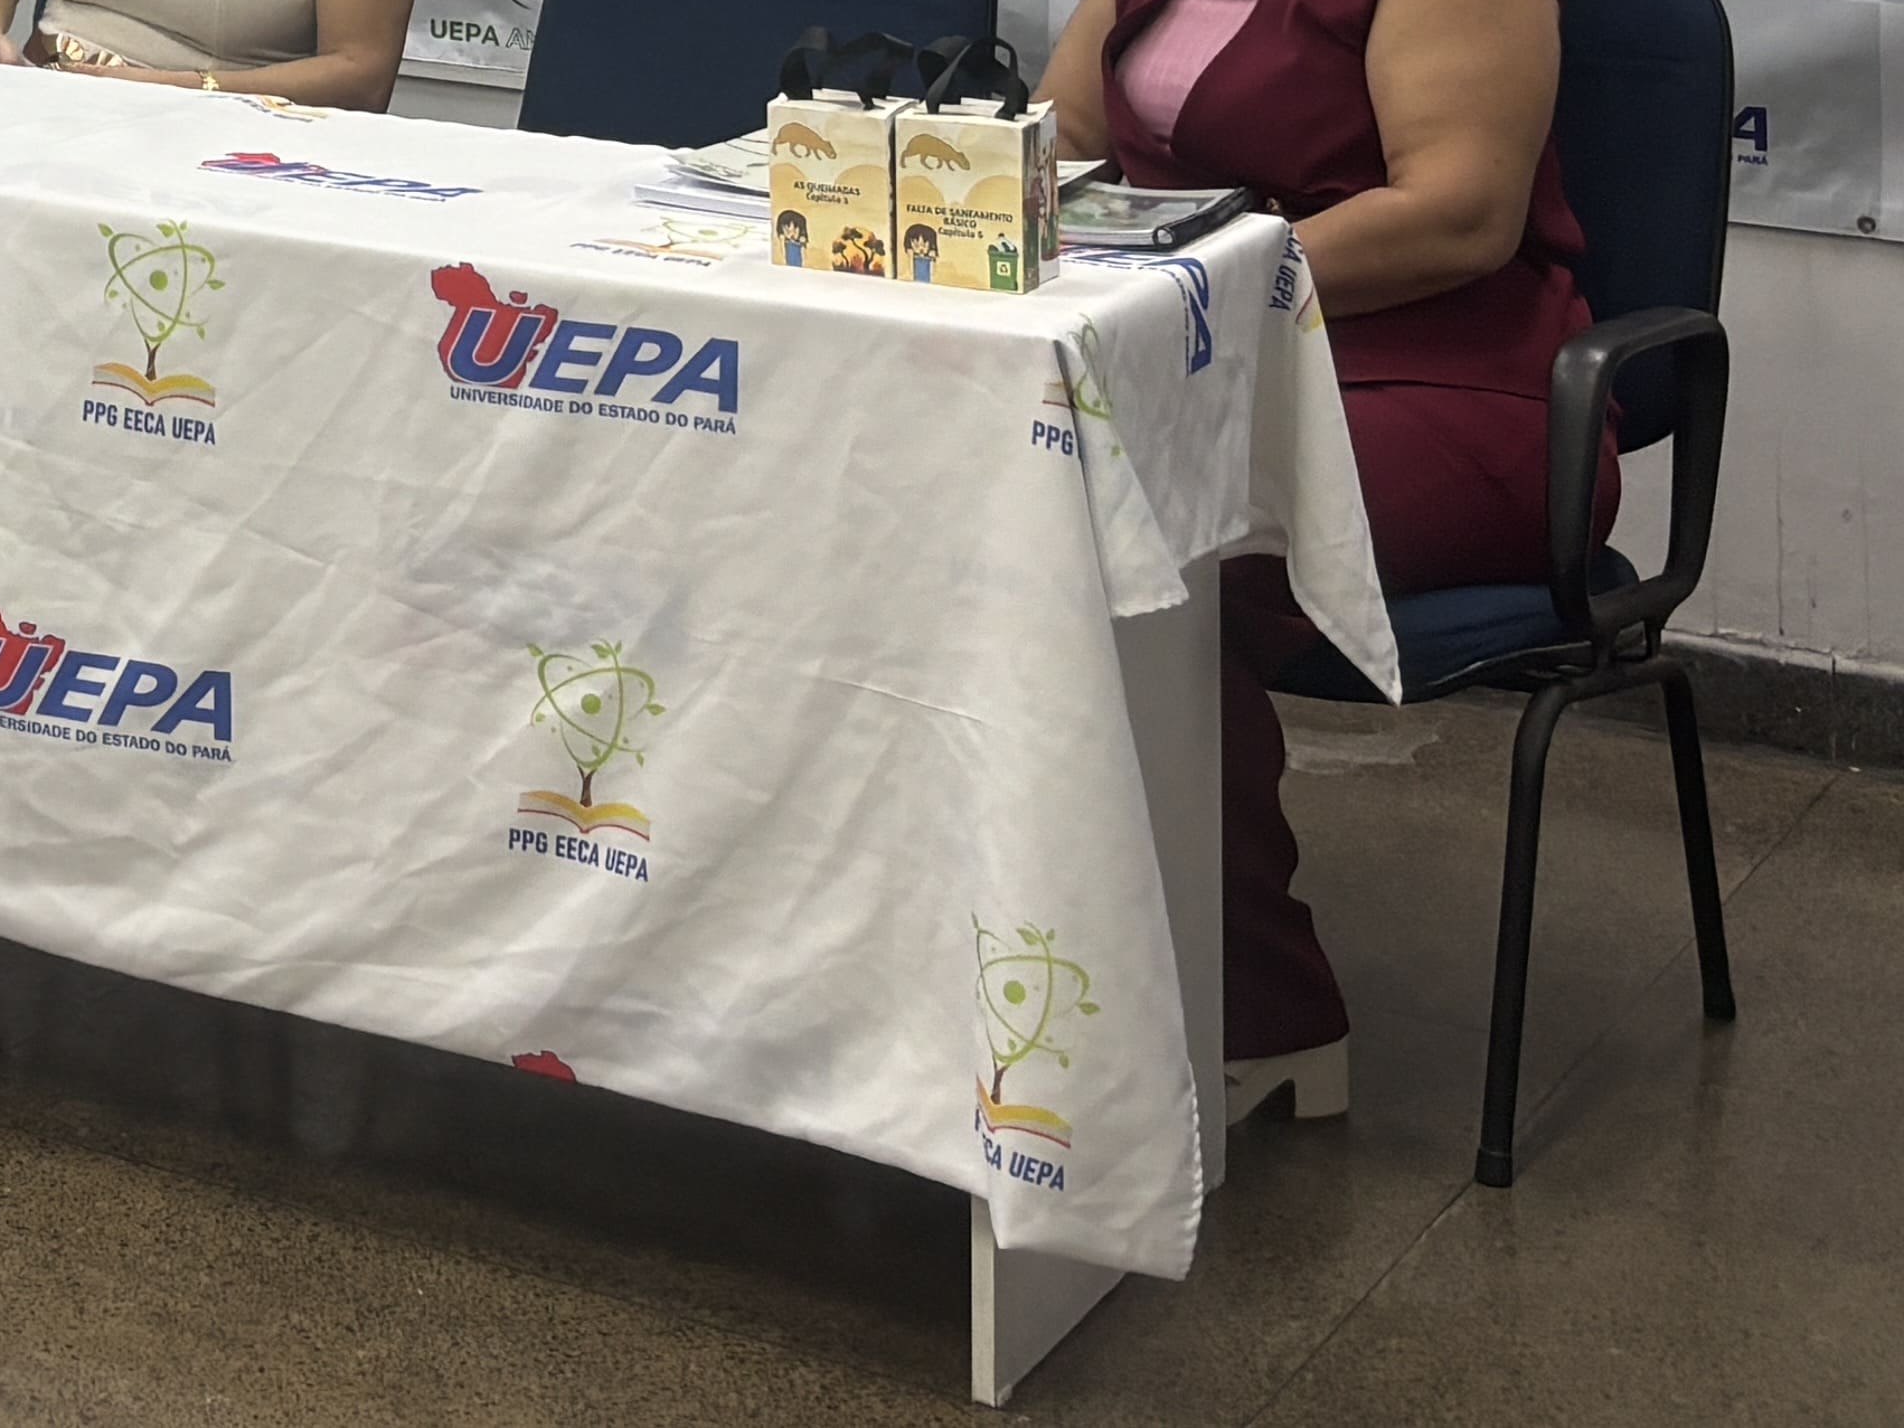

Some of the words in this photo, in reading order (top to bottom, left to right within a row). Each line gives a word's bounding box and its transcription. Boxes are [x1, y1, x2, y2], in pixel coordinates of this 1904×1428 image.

[450, 305, 740, 413] UEPA
[83, 399, 119, 427] PPG
[122, 406, 167, 438] EECA
[172, 414, 216, 447] UEPA
[450, 386, 564, 414] UNIVERSIDADE
[569, 401, 594, 416] DO
[599, 403, 661, 424] ESTADO
[667, 413, 687, 429] DO
[693, 413, 737, 435] PARÁ
[509, 828, 549, 854] PPG
[555, 835, 600, 868] EECA
[605, 846, 649, 883] UEPA
